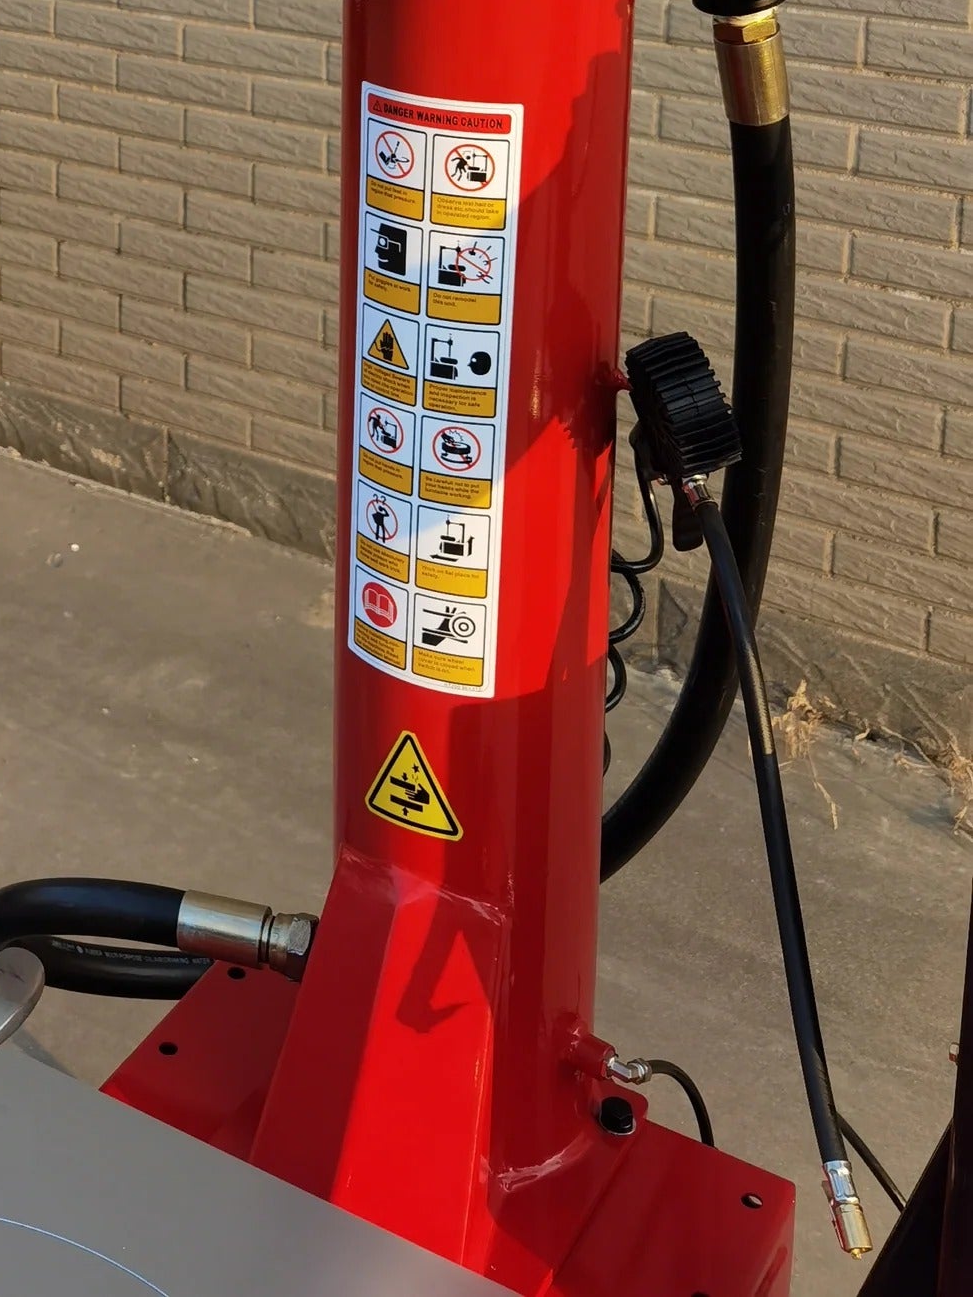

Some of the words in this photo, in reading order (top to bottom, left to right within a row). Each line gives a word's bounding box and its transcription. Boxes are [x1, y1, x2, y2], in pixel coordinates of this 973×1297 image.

[383, 102, 414, 119] DANGER
[417, 110, 458, 126] WARNING
[461, 117, 503, 129] CAUTION
